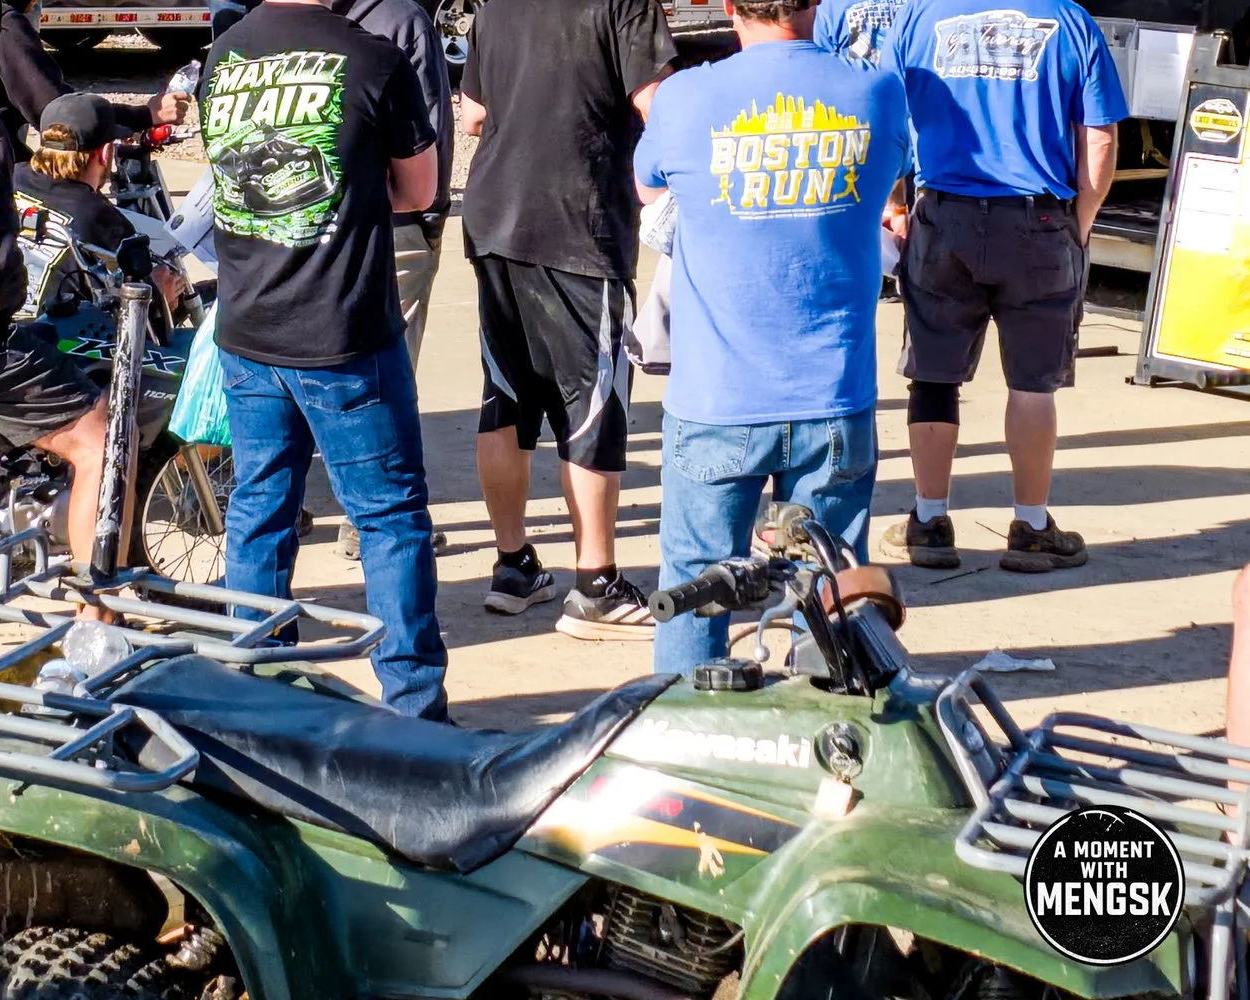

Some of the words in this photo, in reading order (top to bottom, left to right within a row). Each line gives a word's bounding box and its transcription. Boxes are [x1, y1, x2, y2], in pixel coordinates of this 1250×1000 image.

[215, 61, 279, 95] MAX
[207, 84, 331, 137] BLAIR
[710, 130, 871, 174] BOSTON
[740, 168, 836, 208] RUN
[68, 336, 187, 376] KX
